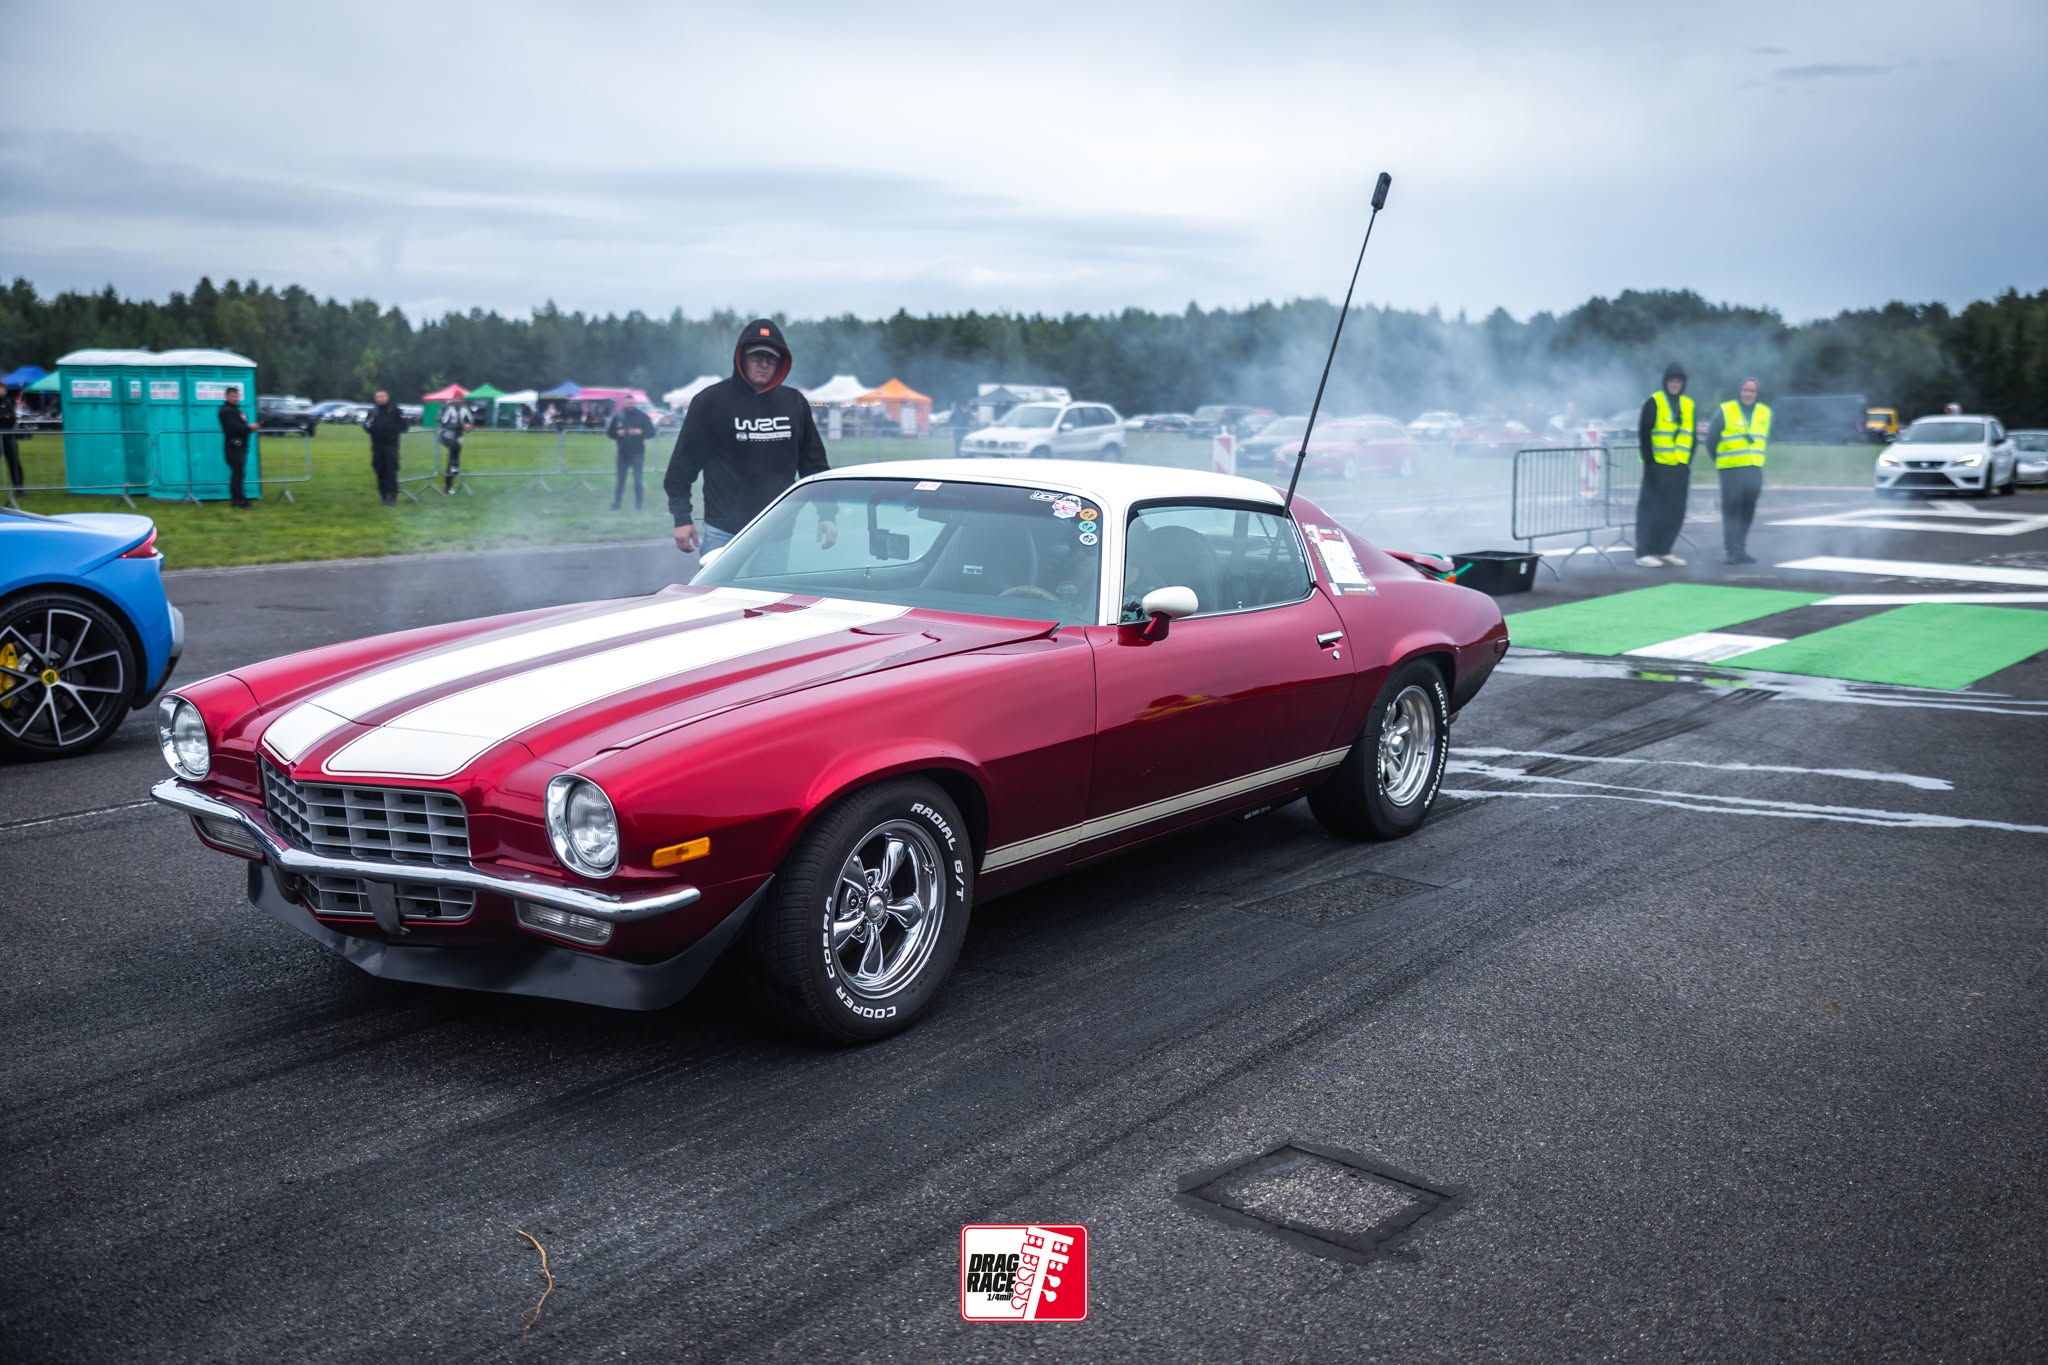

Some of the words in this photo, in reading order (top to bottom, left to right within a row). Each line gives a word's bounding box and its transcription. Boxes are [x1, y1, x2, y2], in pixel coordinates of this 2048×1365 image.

[734, 416, 791, 431] WRC
[1434, 682, 1448, 727] MICKEY
[1424, 735, 1447, 809] THOMPSON
[910, 803, 956, 851] RADIAL
[954, 859, 964, 902] G/T
[823, 896, 836, 979] COBRA
[835, 985, 897, 1019] COOPER
